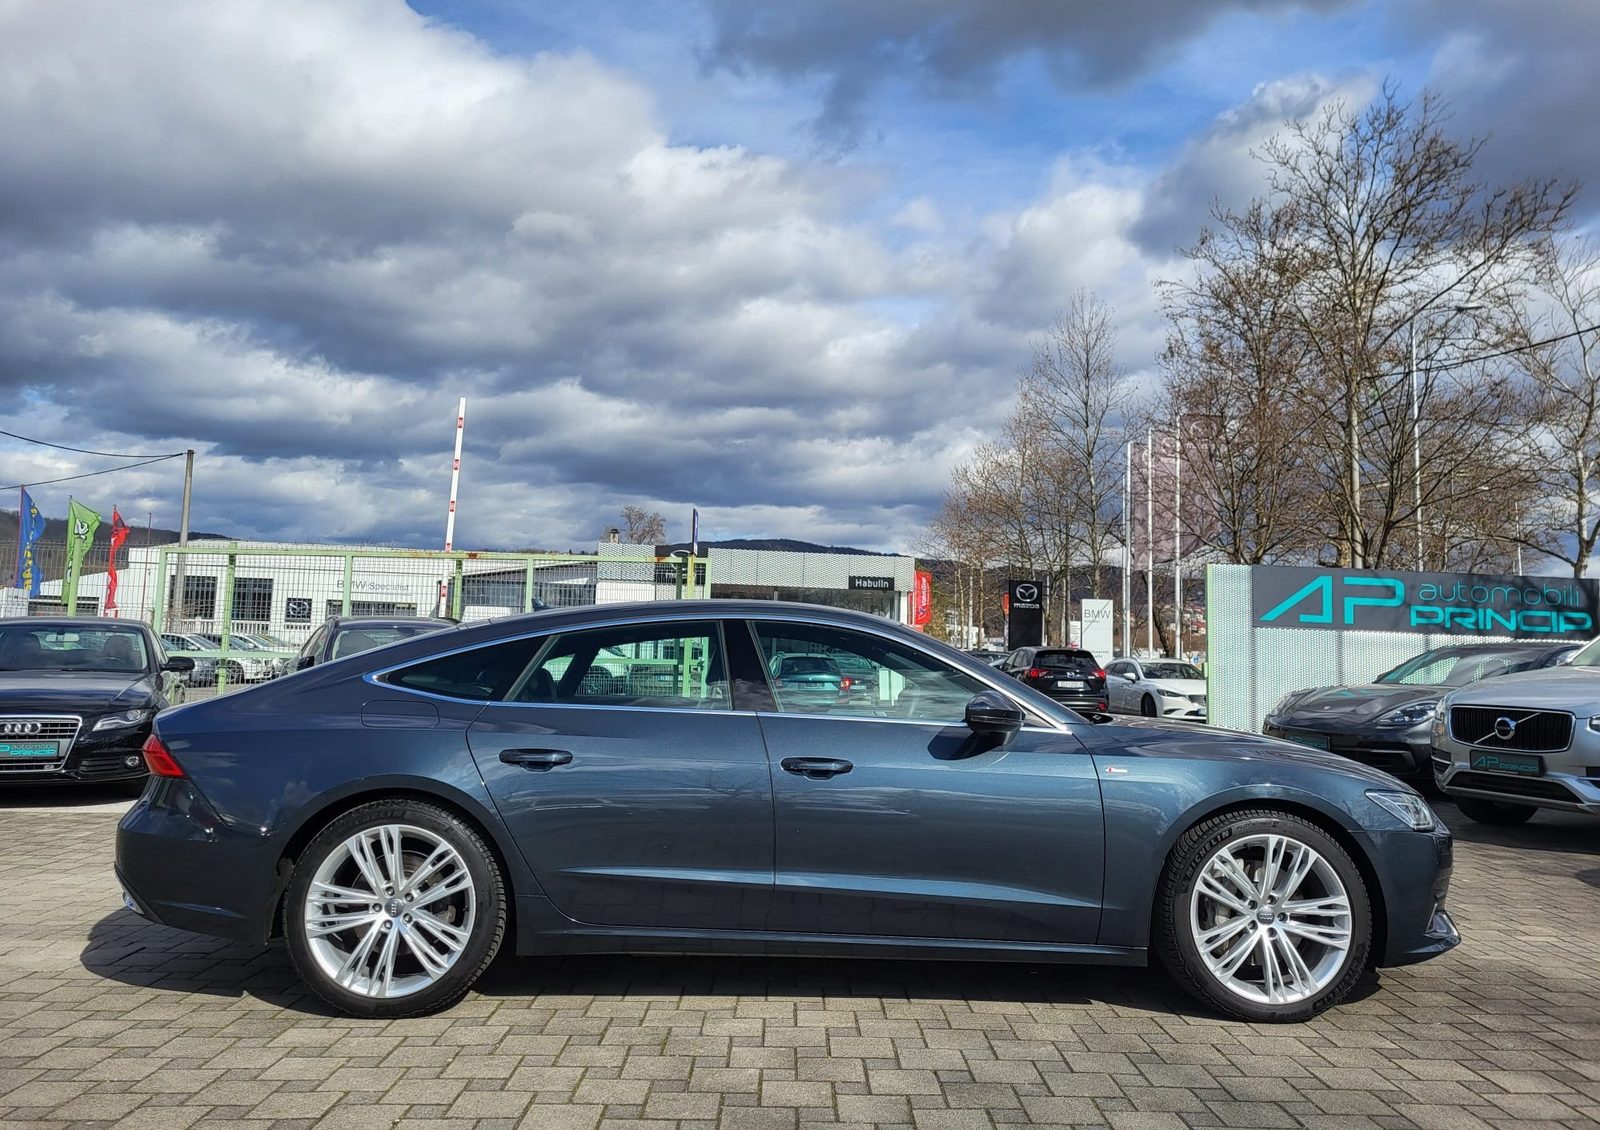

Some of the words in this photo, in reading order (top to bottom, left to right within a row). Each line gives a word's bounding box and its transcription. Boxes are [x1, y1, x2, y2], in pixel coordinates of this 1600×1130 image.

[855, 579, 889, 588] Habulin
[1419, 583, 1579, 606] automobili
[1259, 576, 1405, 624] AP
[1084, 609, 1111, 618] BMW
[1411, 606, 1592, 632] PRINCIP
[1472, 756, 1499, 767] AP
[1186, 829, 1231, 878] MICHELIN
